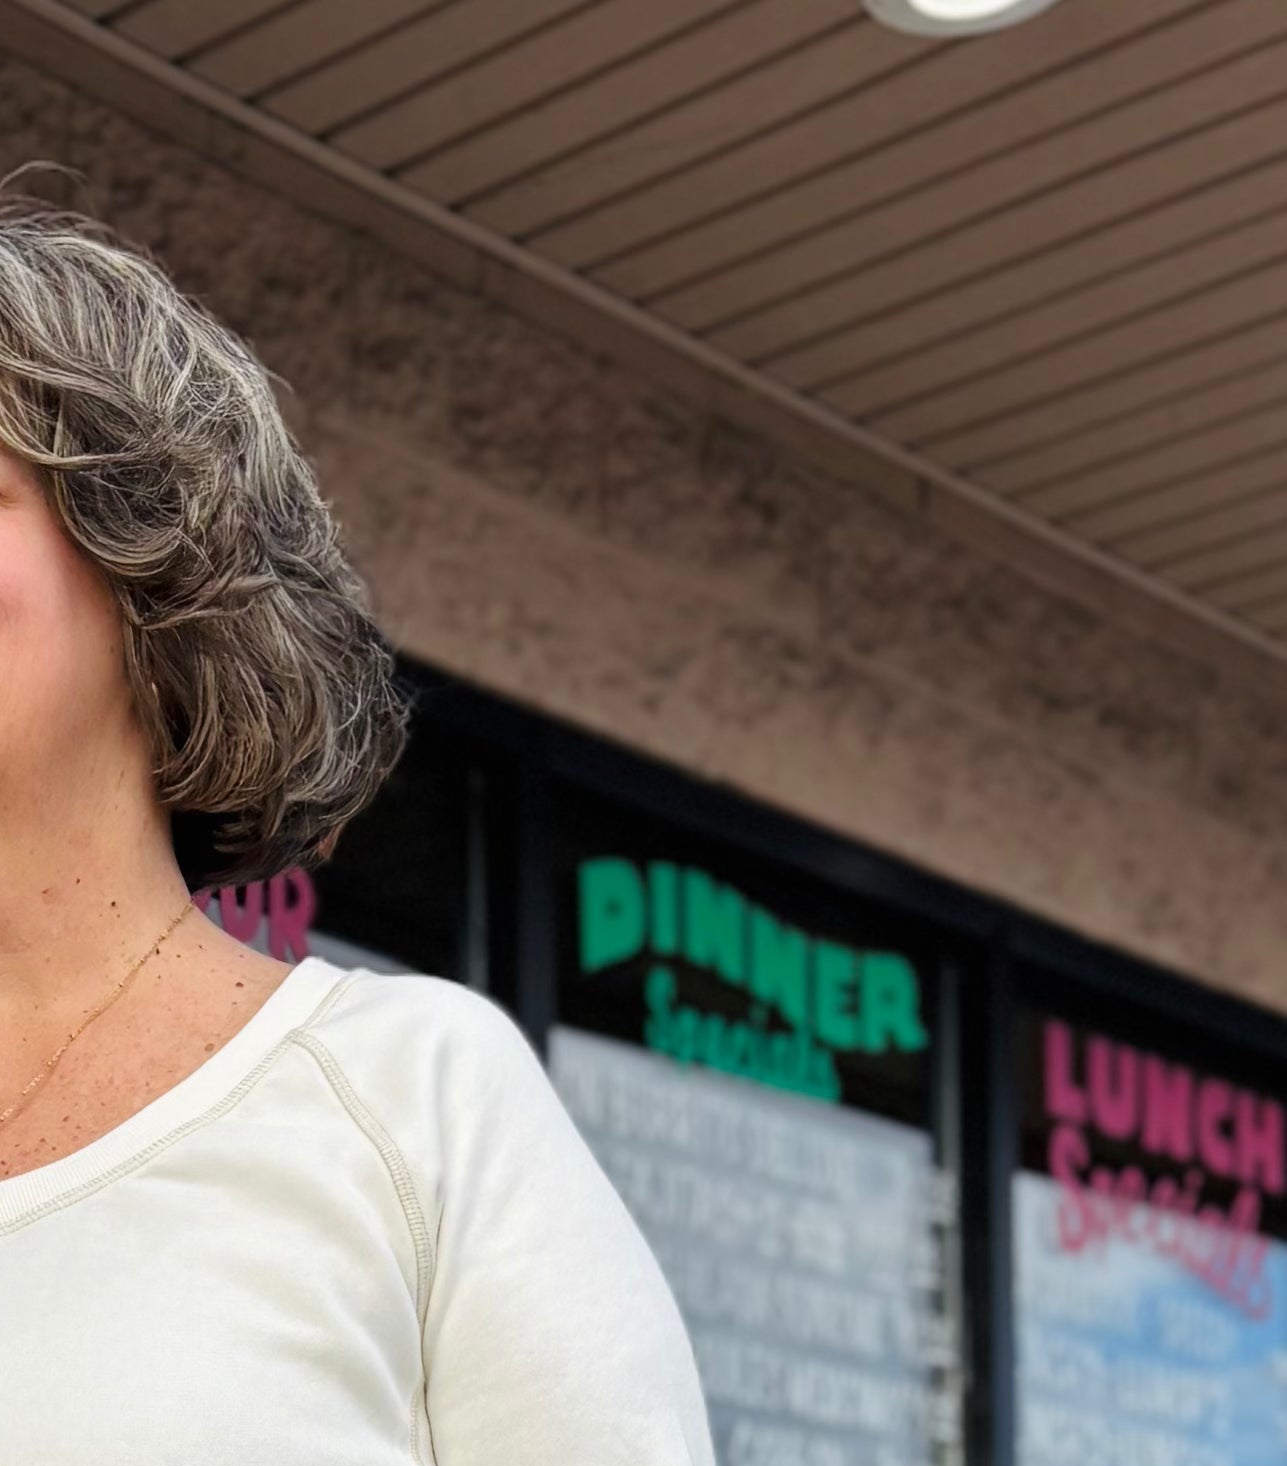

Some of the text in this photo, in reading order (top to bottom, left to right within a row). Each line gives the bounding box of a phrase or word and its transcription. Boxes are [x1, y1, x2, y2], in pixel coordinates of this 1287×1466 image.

[577, 856, 928, 1053] DINNER
[1043, 1019, 1286, 1194] LUNCH
[1047, 1126, 1275, 1321] Specials
